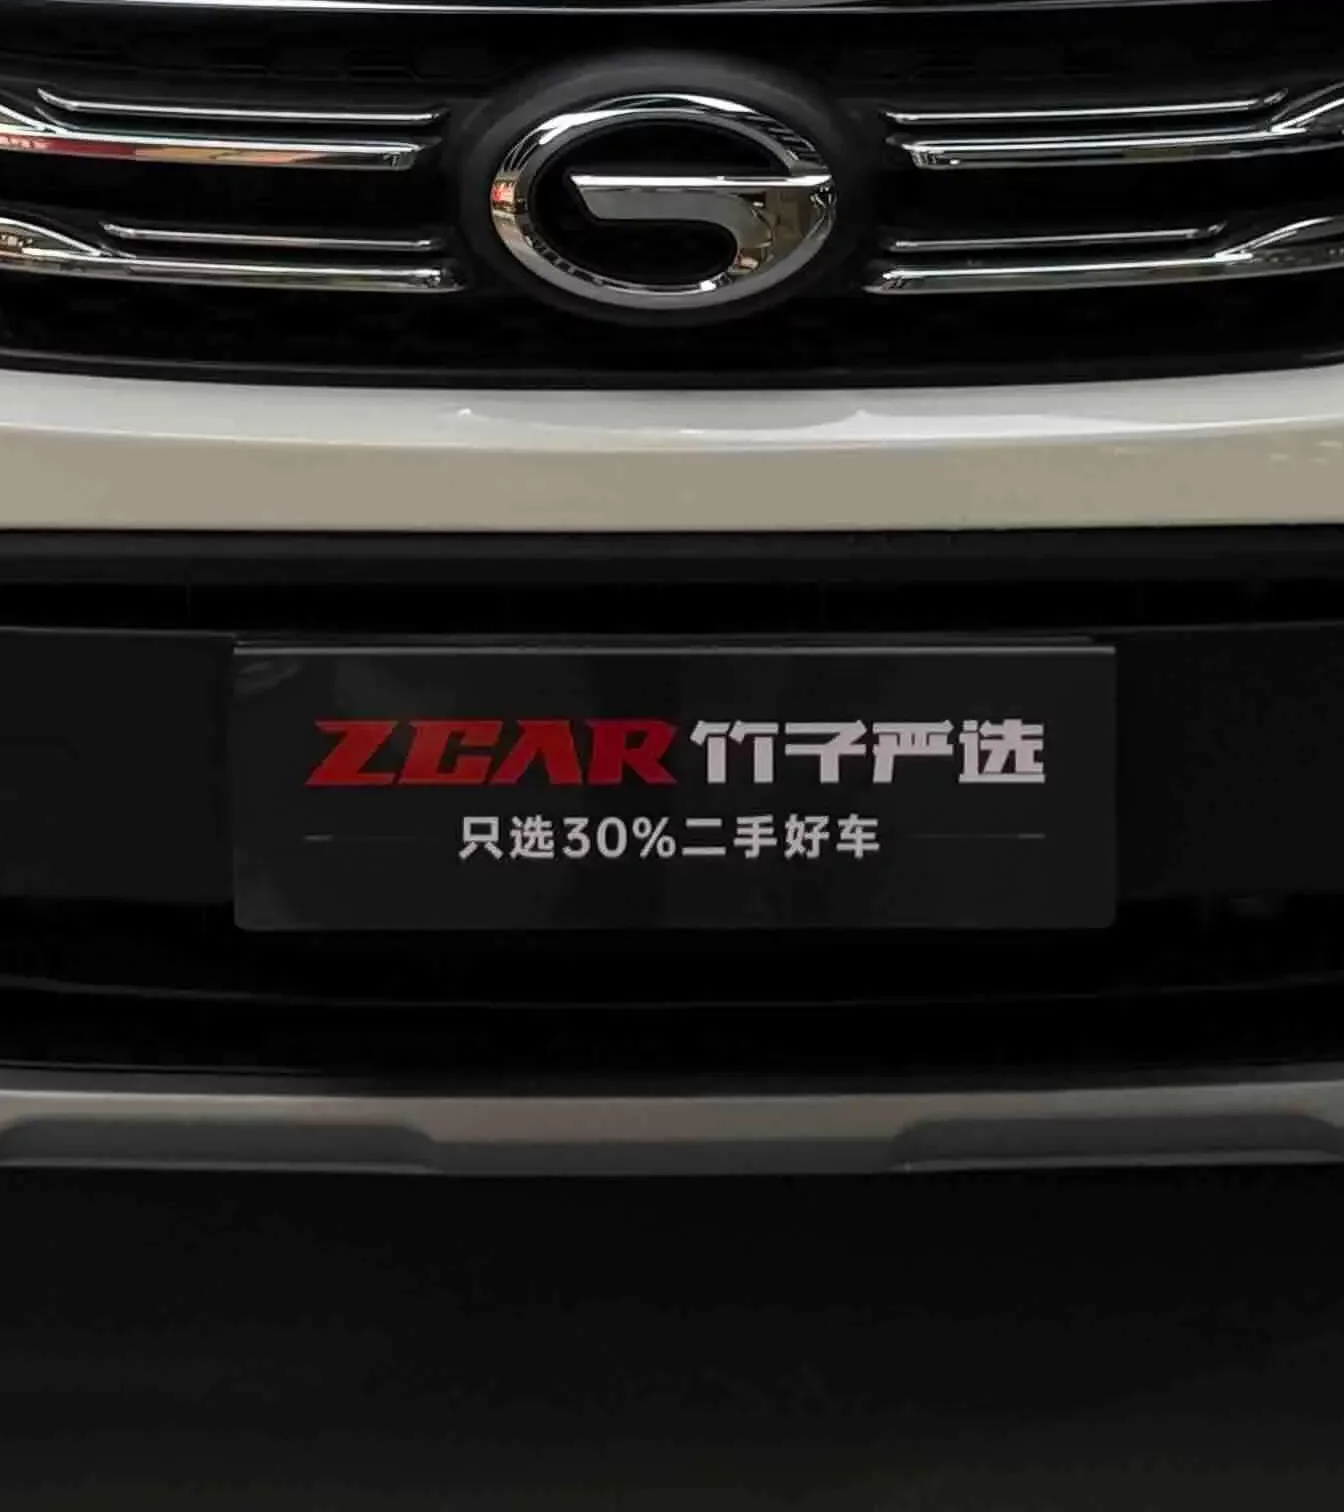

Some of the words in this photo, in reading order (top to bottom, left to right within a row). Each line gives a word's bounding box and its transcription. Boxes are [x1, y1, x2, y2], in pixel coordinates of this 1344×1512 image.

[305, 720, 678, 785] ZCAR
[689, 719, 1046, 784] 竹子严选
[457, 814, 881, 860] 只选30%二手好车
